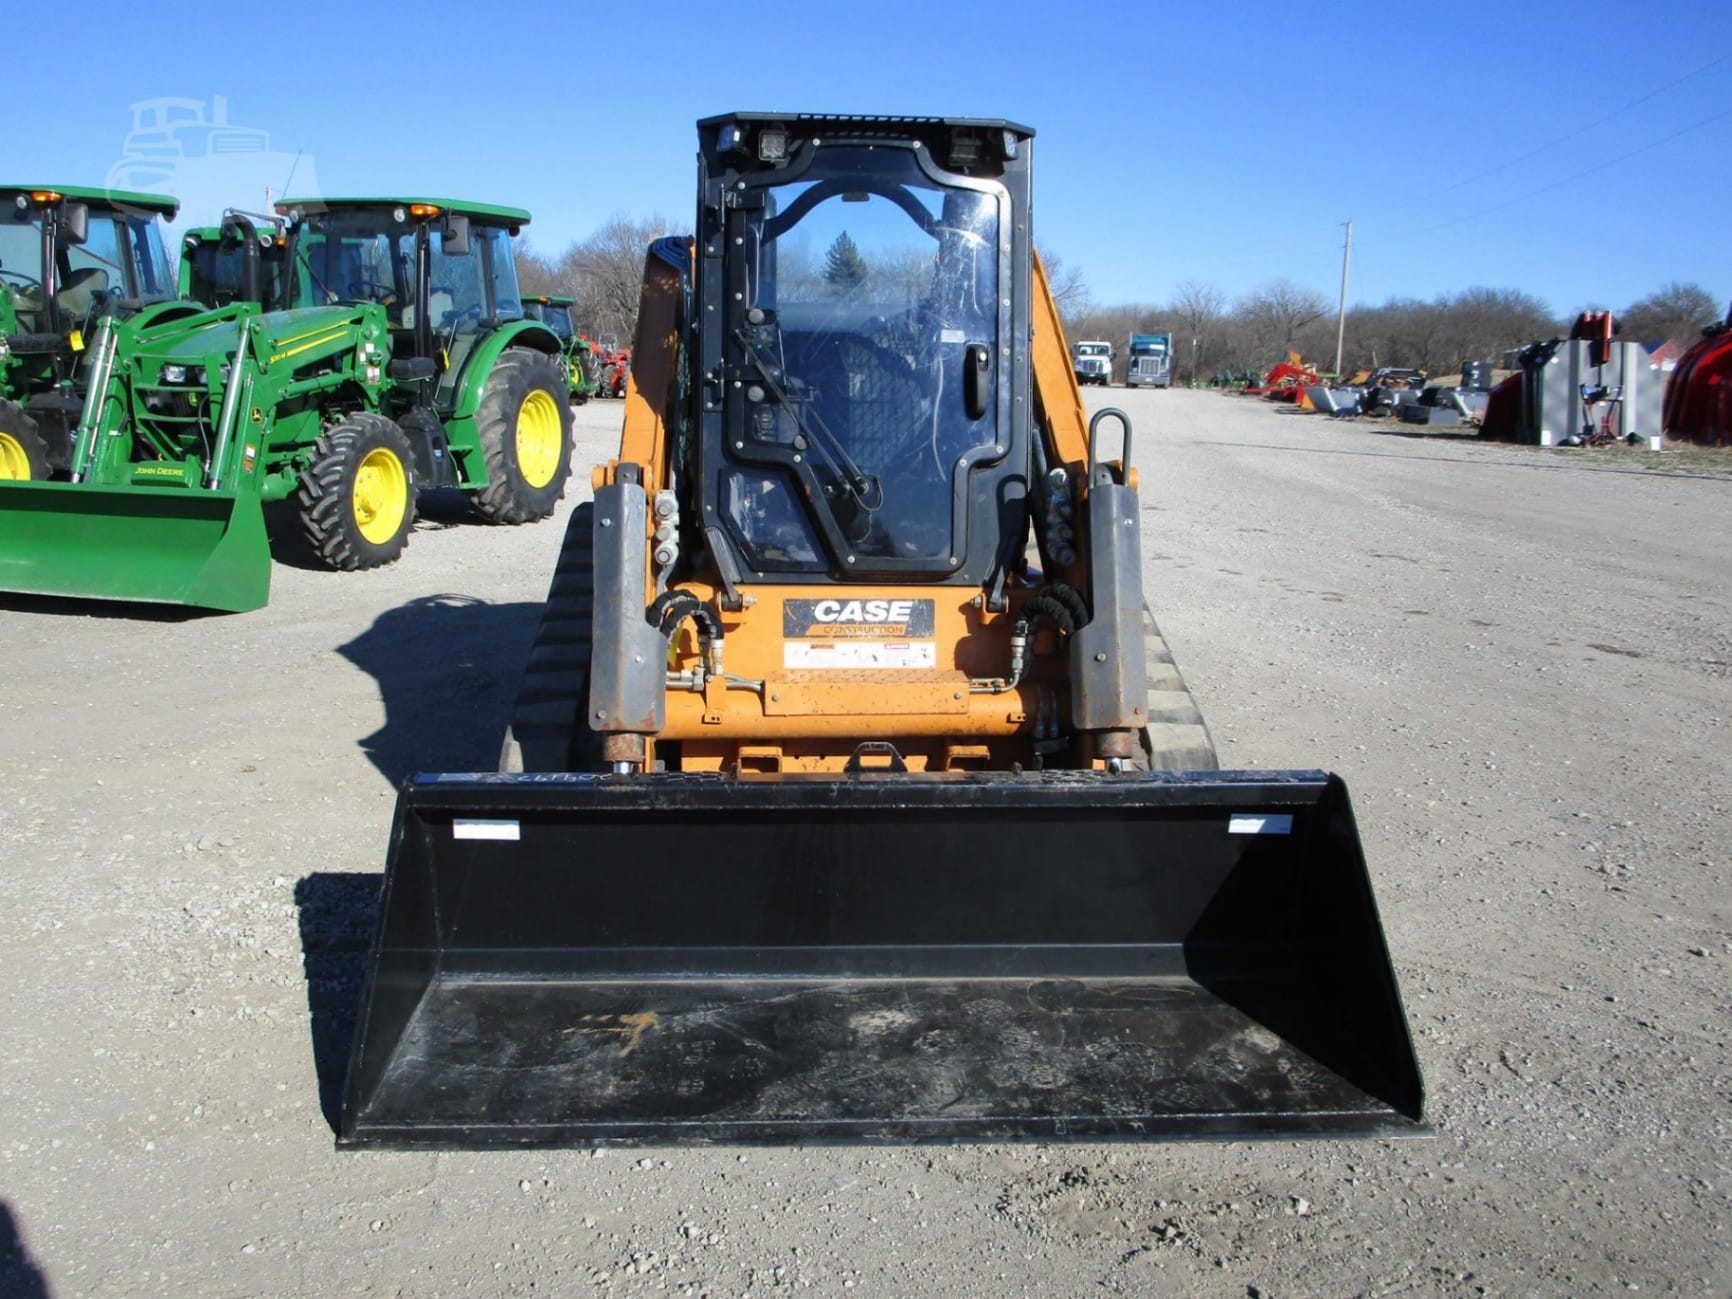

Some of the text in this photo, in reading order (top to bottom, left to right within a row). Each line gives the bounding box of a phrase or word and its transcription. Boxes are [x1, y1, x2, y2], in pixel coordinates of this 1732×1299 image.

[135, 467, 184, 476] JOHN DEERE
[814, 600, 913, 622] CASE
